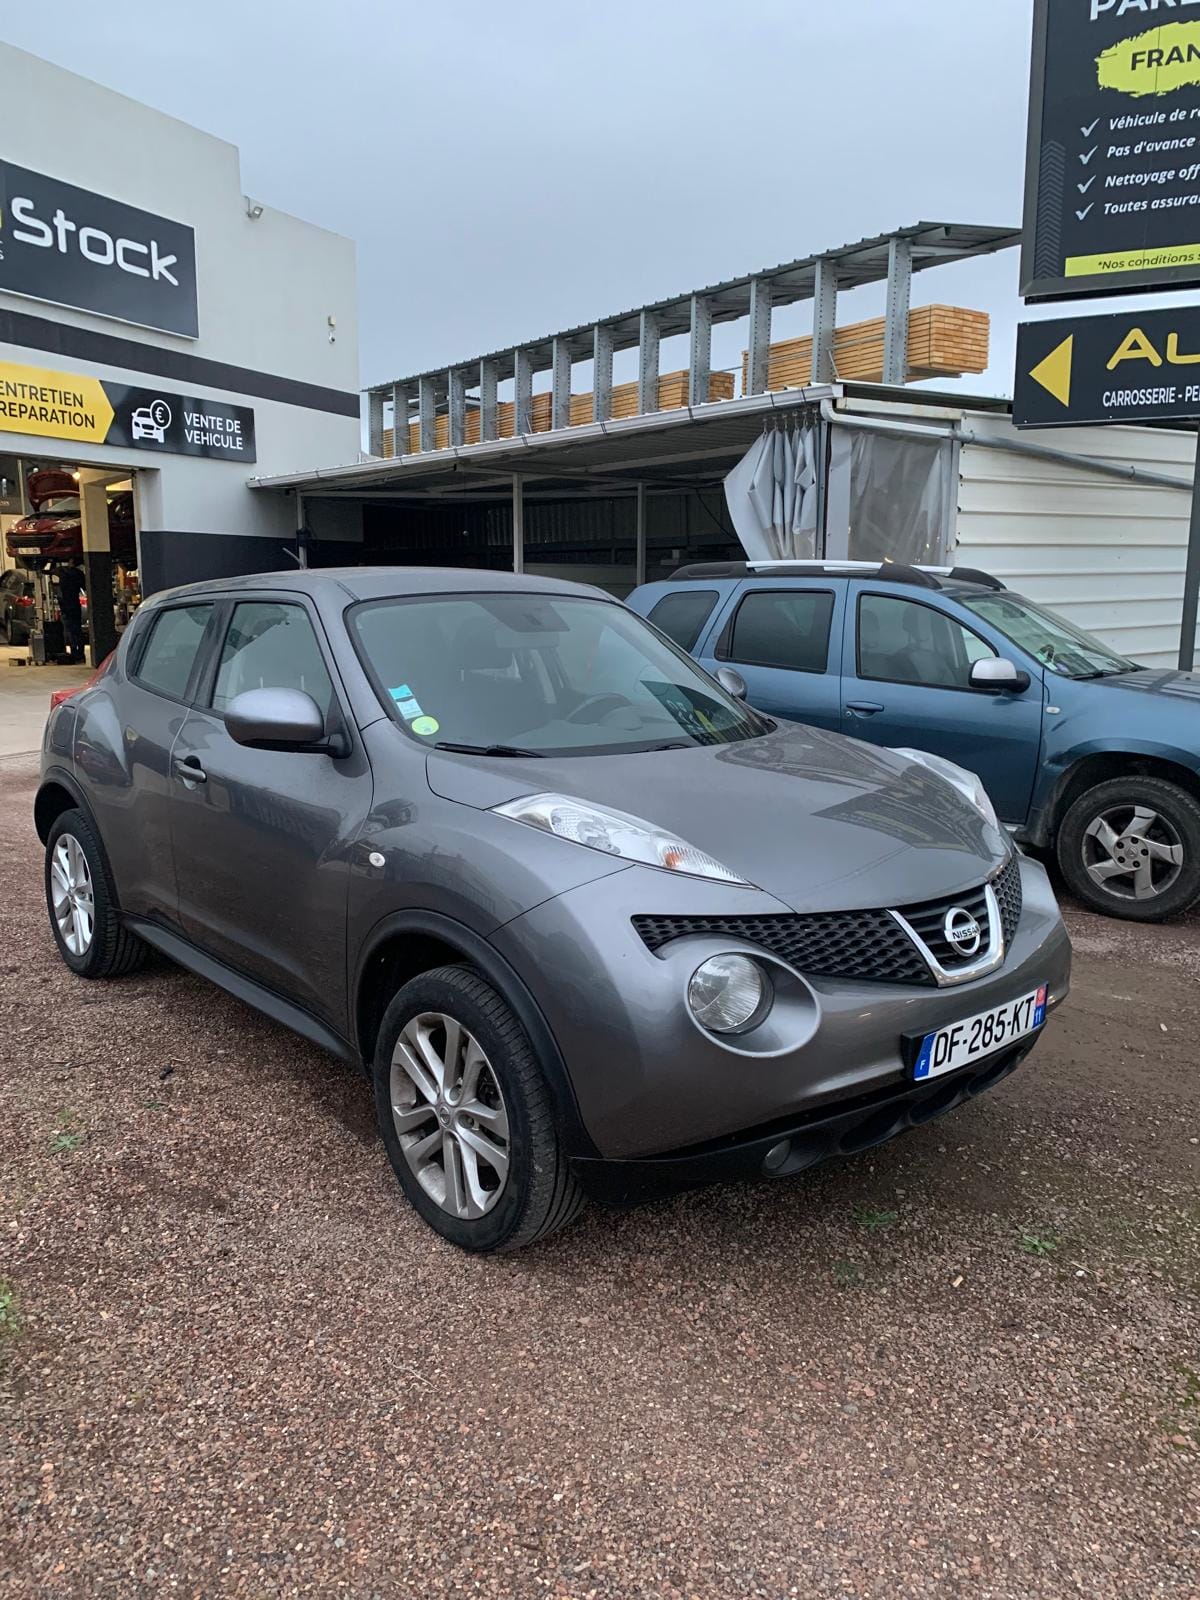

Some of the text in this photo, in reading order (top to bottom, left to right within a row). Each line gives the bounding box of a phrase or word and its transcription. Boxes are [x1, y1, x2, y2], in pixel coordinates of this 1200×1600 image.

[1131, 44, 1200, 71] FRAN
[1109, 112, 1166, 130] Véhicule
[1169, 109, 1187, 121] de
[1107, 137, 1196, 158] Pas d'avance
[1105, 169, 1175, 187] Nettoyage
[1104, 194, 1200, 215] Toutes assura
[11, 197, 179, 286] Stock
[1128, 252, 1194, 267] conditions
[1103, 387, 1176, 407] CARROSSERIE
[0, 401, 95, 429] REPARATION
[184, 411, 241, 434] VENTE DE
[185, 429, 243, 451] VEHICULE
[934, 995, 1035, 1068] DF-285-KT
[920, 1059, 926, 1070] F
